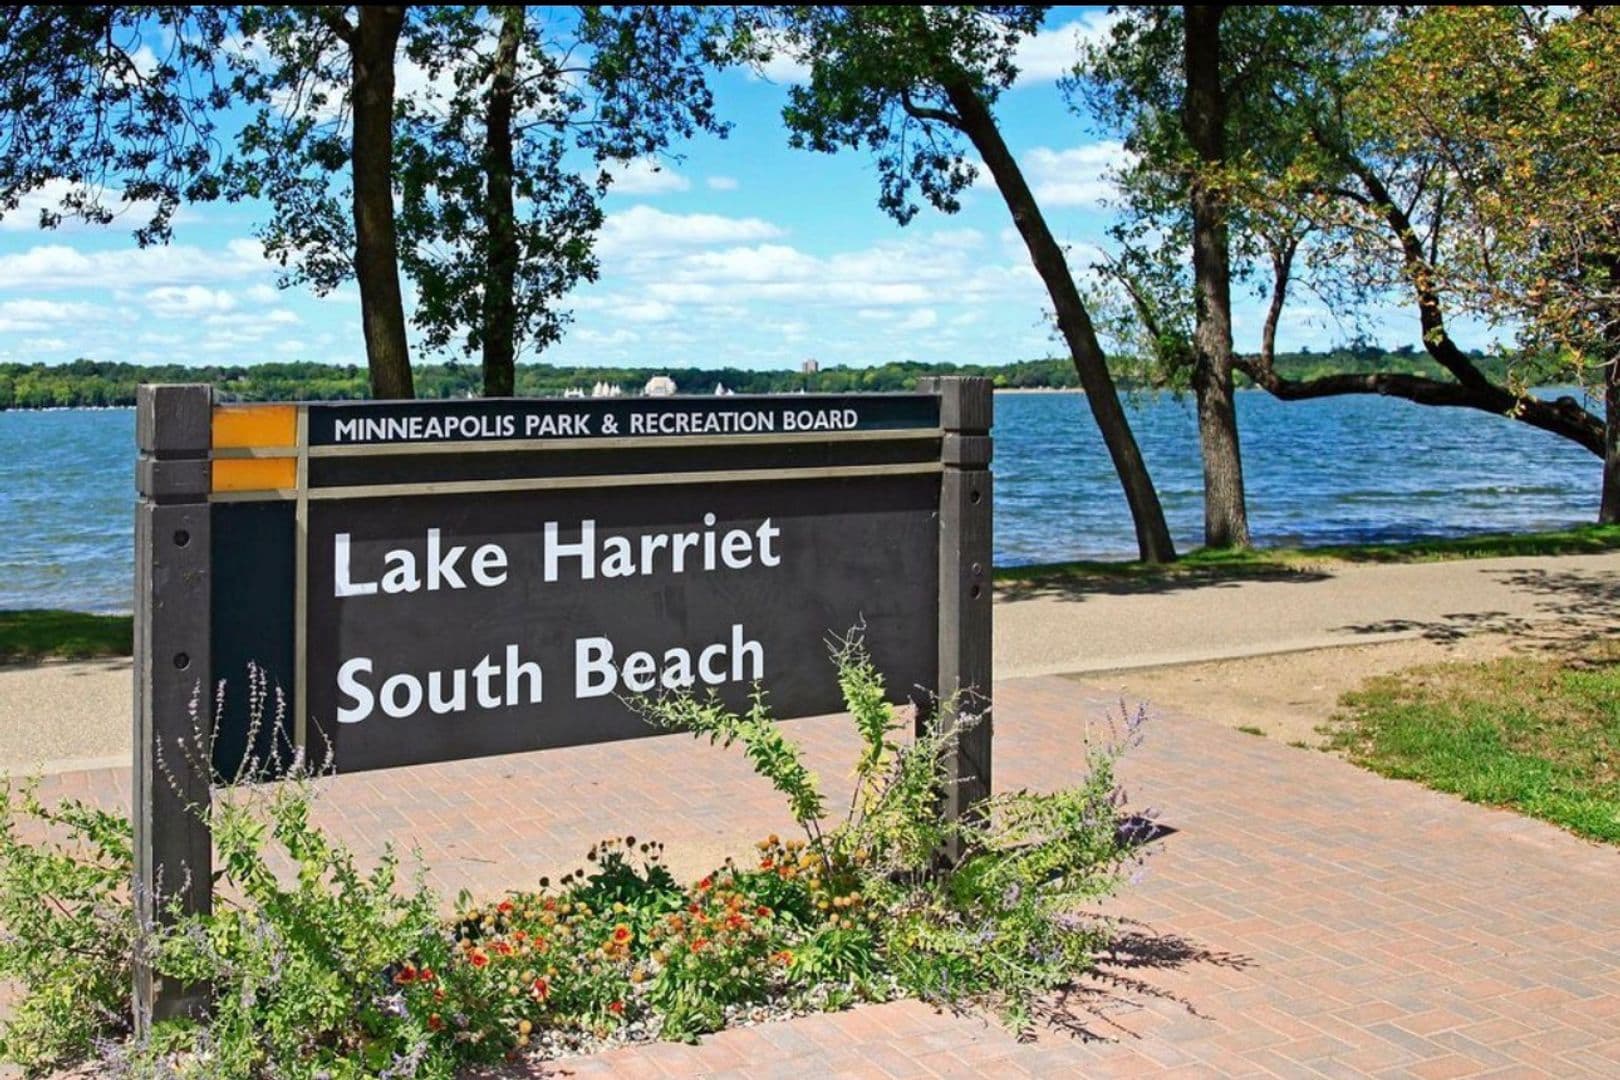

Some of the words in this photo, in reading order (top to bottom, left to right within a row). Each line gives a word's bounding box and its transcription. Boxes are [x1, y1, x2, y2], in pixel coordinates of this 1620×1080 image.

[334, 414, 515, 442] MINNEAPOLIS
[525, 414, 591, 436] PARK
[601, 413, 619, 434] &
[630, 411, 774, 434] RECREATION
[783, 409, 858, 431] BOARD
[334, 527, 508, 597] Lake
[543, 512, 781, 583] Harriet
[336, 643, 543, 724] South
[575, 623, 764, 699] Beach
